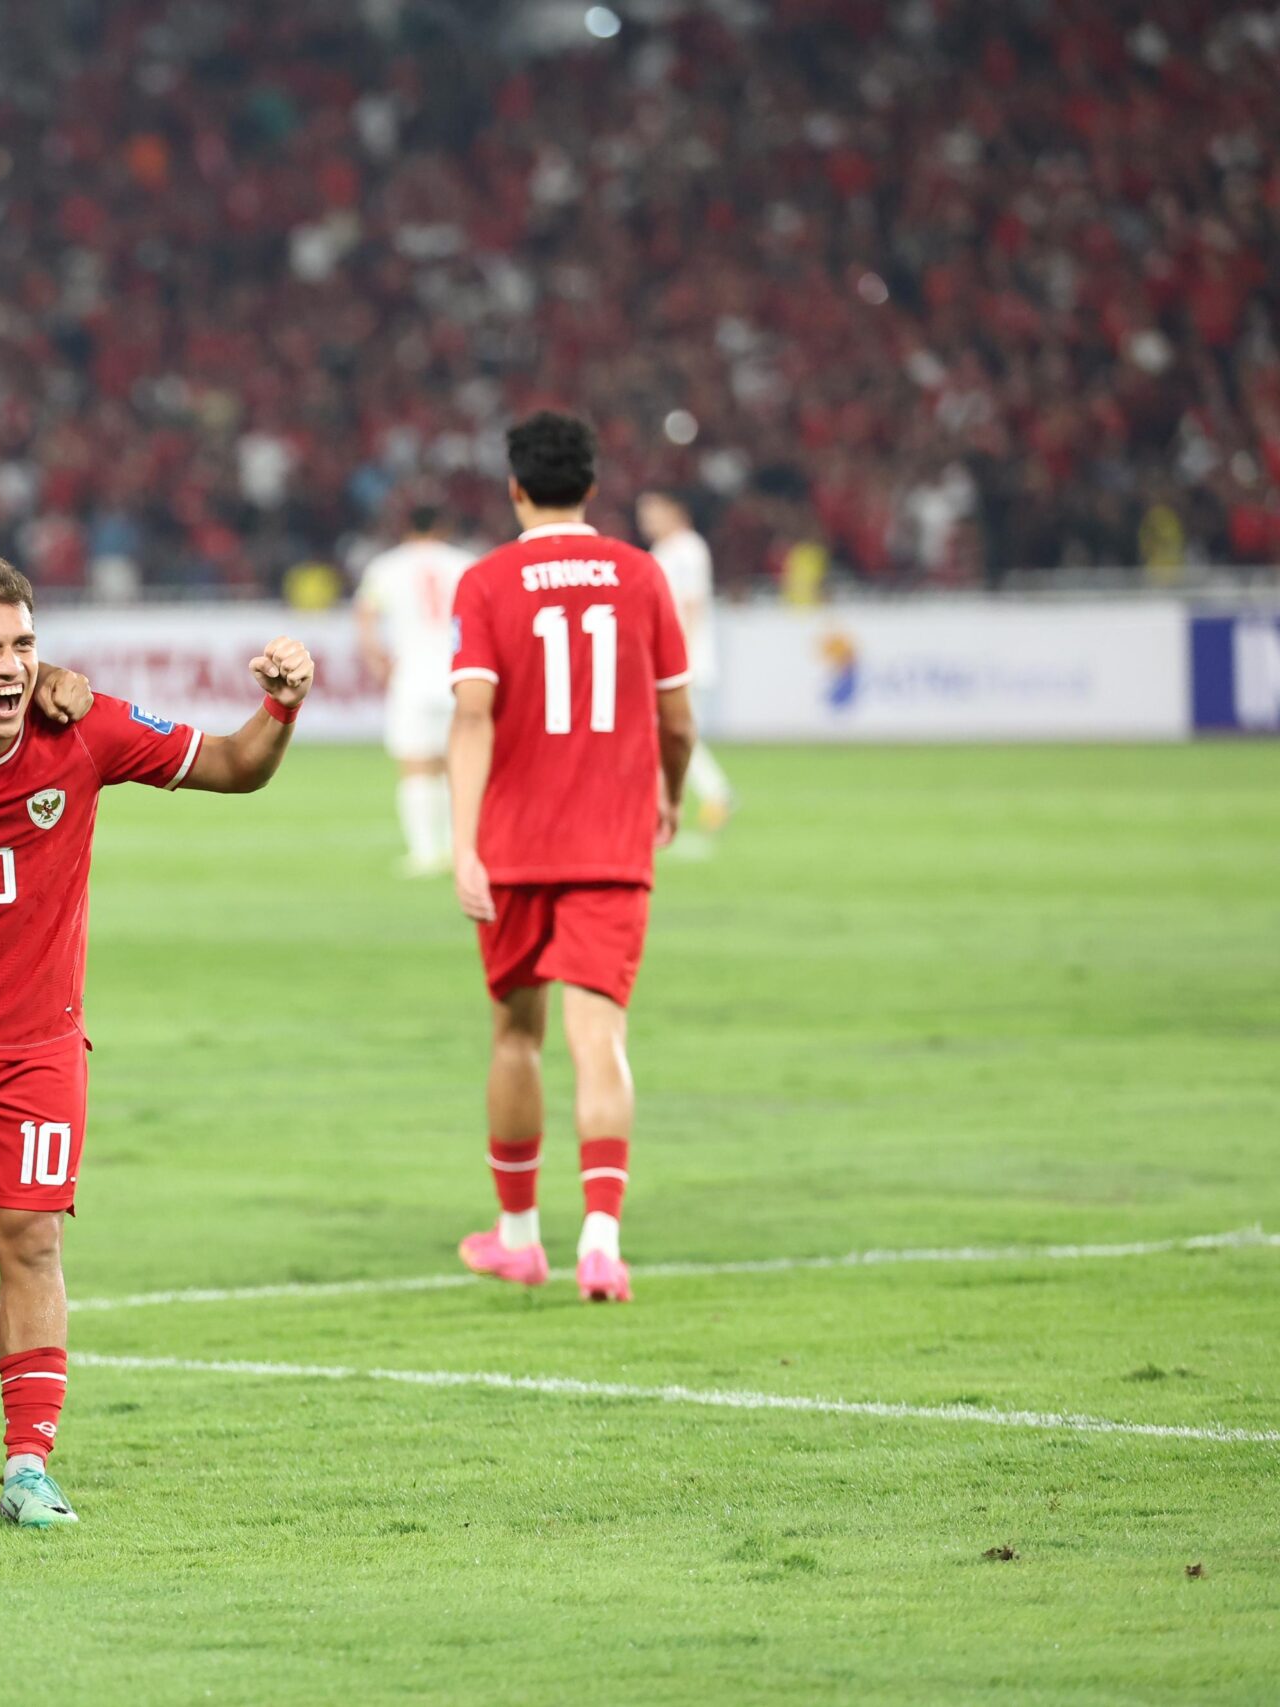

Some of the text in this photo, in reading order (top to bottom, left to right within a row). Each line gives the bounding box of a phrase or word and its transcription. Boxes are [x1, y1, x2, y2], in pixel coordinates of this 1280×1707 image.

[521, 559, 620, 592] STRUICK
[532, 604, 618, 735] 11
[20, 1120, 71, 1186] 10
